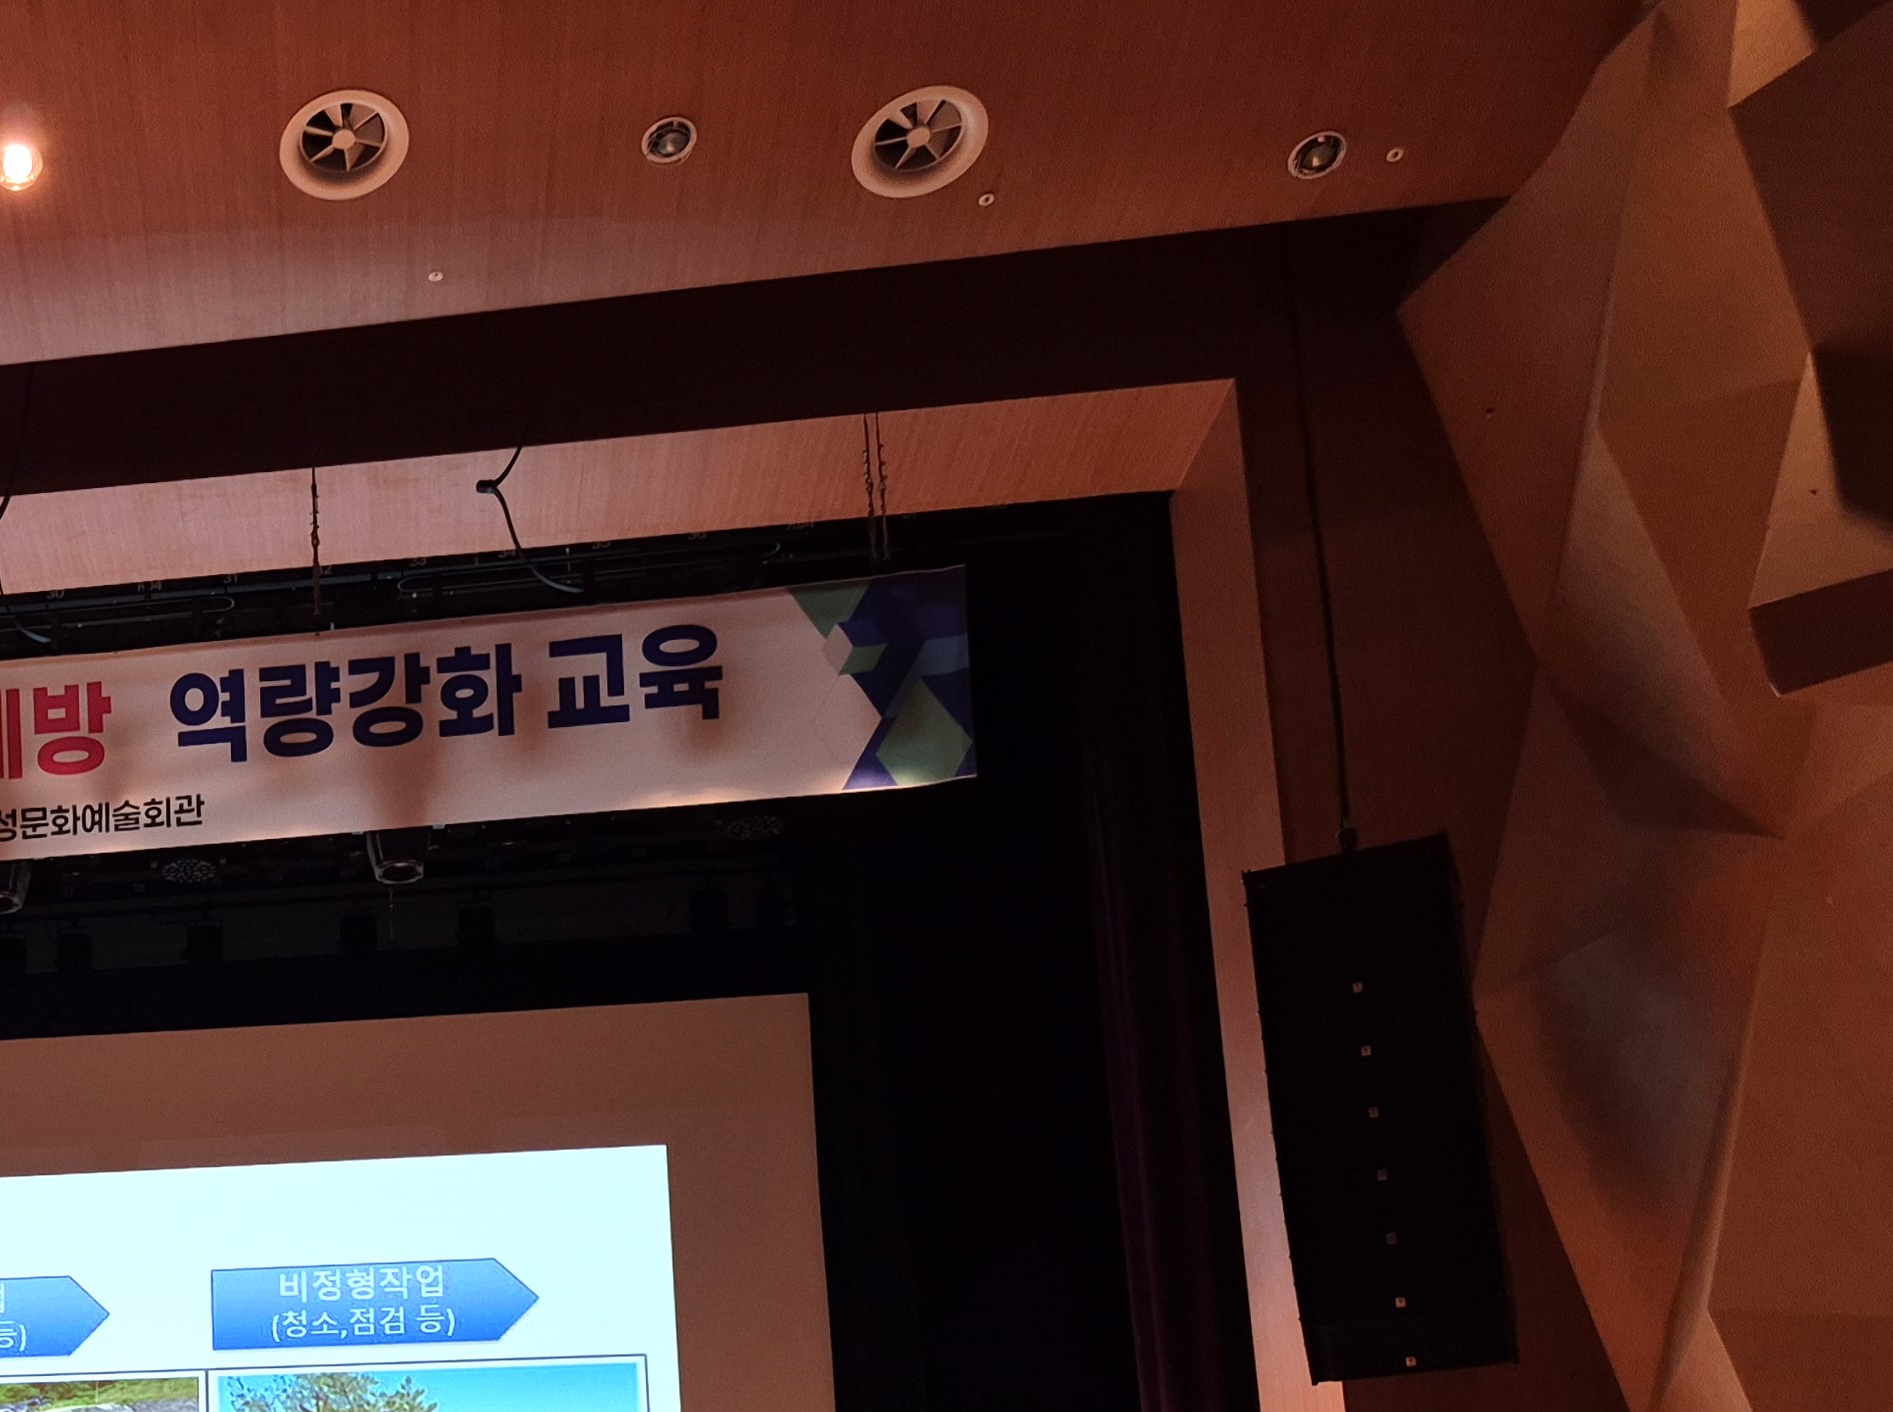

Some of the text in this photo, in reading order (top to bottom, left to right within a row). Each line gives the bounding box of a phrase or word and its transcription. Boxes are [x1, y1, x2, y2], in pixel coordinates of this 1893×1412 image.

[169, 643, 522, 763] 역량강화
[546, 622, 723, 729] 교육
[279, 1265, 444, 1303] 비정형작업
[272, 1304, 456, 1343] (청소,점검 등)
